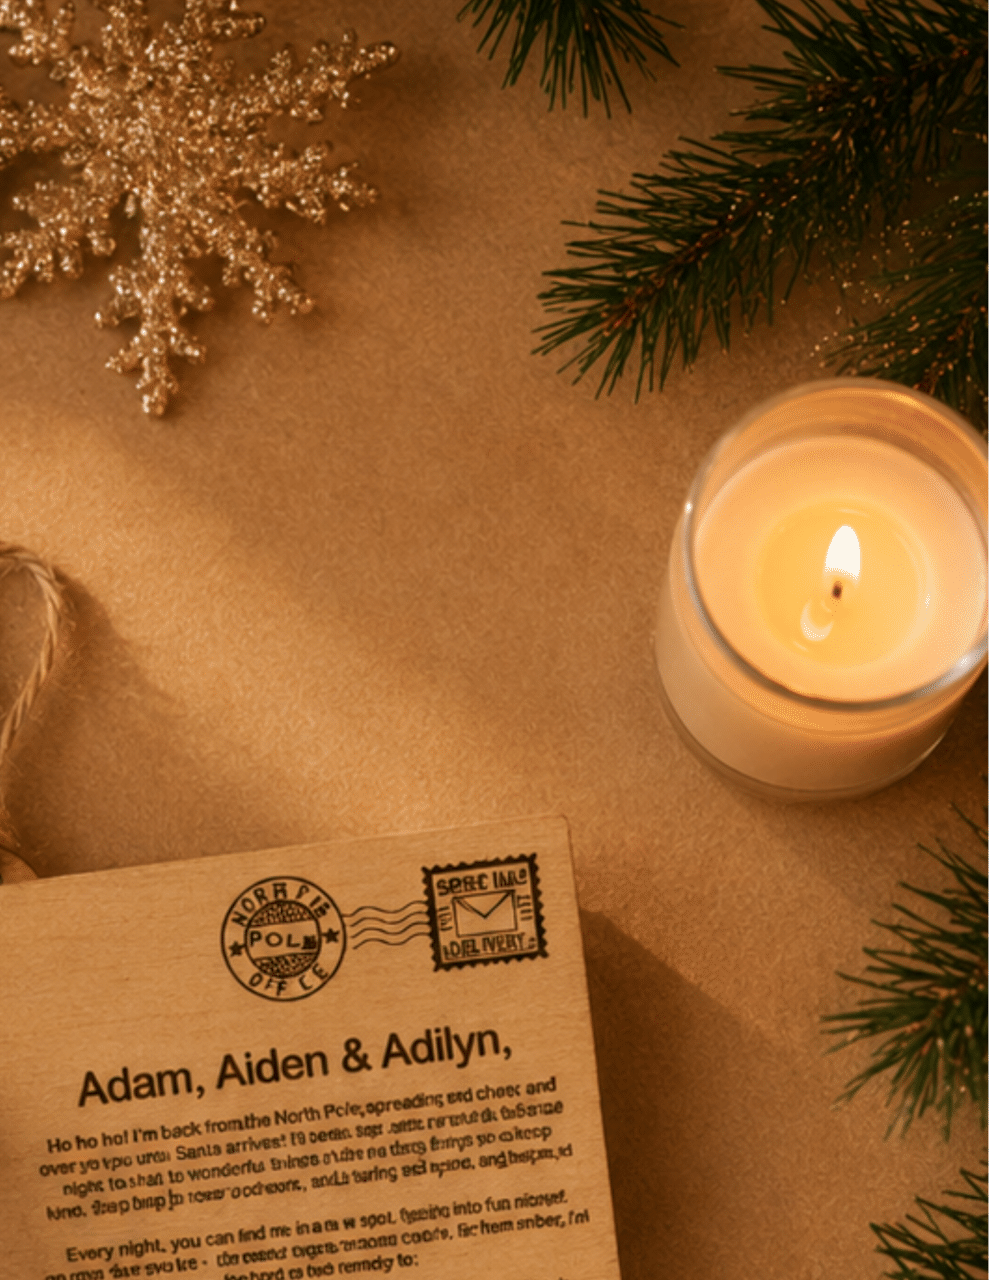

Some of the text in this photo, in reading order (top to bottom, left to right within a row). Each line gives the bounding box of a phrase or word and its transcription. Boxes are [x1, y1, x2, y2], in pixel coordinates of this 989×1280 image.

[78, 1026, 512, 1107] Adam, Aiden & Adilyn,
[47, 1138, 72, 1153] Ho
[75, 1135, 98, 1150] ho
[133, 1128, 158, 1143] I'm
[160, 1122, 202, 1140] back
[274, 1107, 321, 1125] North
[526, 1076, 556, 1095] and
[66, 1247, 114, 1262] Every
[170, 1237, 201, 1254] you
[206, 1232, 234, 1246] can
[485, 1197, 511, 1212] fun
